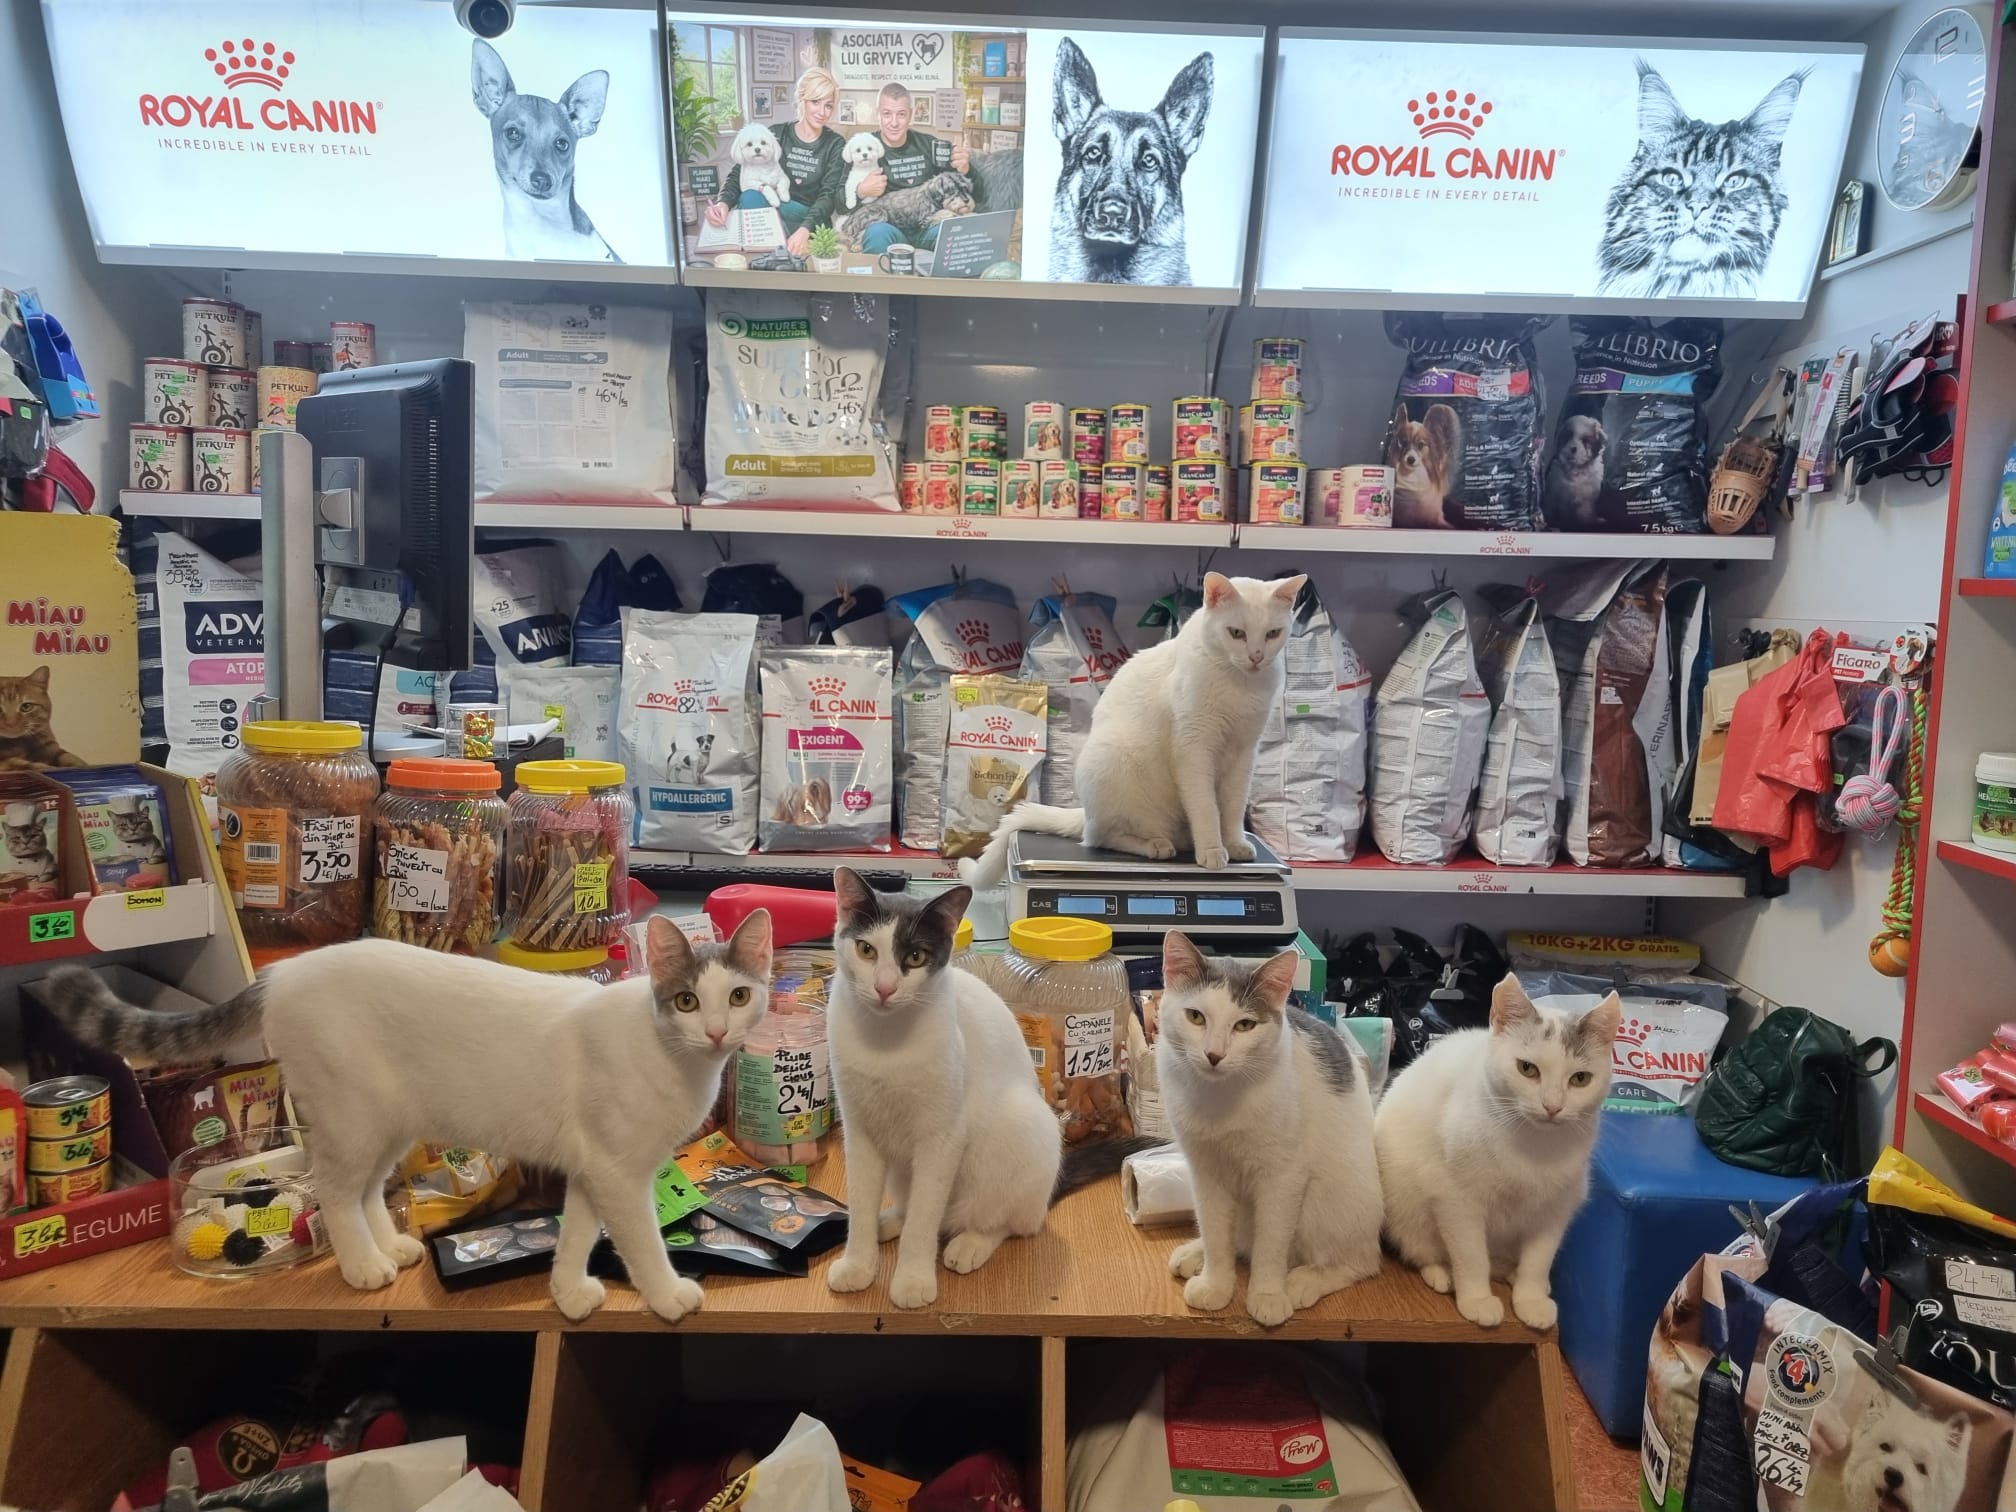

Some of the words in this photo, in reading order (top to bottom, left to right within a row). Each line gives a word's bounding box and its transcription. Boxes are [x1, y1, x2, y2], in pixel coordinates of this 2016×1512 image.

[841, 52, 860, 65] LUI
[863, 51, 913, 65] GRYVEY
[139, 94, 254, 130] ROYAL
[260, 98, 377, 134] CANIN
[158, 138, 245, 152] INCREDIBLE
[250, 141, 266, 152] IN
[272, 142, 315, 154] EVERY
[321, 144, 372, 156] DETAIL
[1331, 144, 1436, 178] ROYAL
[1445, 147, 1556, 181] CANIN
[1338, 186, 1421, 199] INCREDIBLE
[1426, 189, 1440, 200] IN
[1445, 189, 1488, 201] EVERY
[1492, 191, 1541, 202] DETAIL
[194, 311, 237, 323] PETKULT
[751, 321, 808, 331] NATURE'S
[335, 334, 368, 344] PETKULT
[751, 329, 808, 338] PROTECTION
[506, 351, 529, 360] Adult
[1624, 356, 1658, 369] Nutrition
[154, 371, 197, 383] PETLT
[1628, 377, 1665, 387] PUPPY
[208, 382, 249, 392] PETKULT
[271, 382, 309, 393] PETKULT
[195, 439, 235, 450] PETKULT
[732, 459, 767, 471] Adult
[936, 529, 961, 537] ROYAL
[962, 529, 988, 538] CANIN
[1505, 547, 1531, 555] CANIN
[490, 600, 510, 614] +25
[195, 613, 265, 637] ADV
[984, 640, 1024, 663] CANIN
[678, 696, 696, 714] 82
[828, 699, 876, 713] CANIN
[801, 735, 845, 746] EXIGENT
[961, 731, 997, 744] ROYAL
[1000, 733, 1037, 747] CANIN
[974, 770, 1004, 780] Bichon
[652, 791, 727, 805] HYPOALLERGENIC
[43, 800, 59, 810] 1+
[719, 815, 731, 825] S
[302, 850, 351, 882] 3,50
[390, 880, 419, 907] 1,50
[1482, 885, 1508, 893] CANIN
[1032, 900, 1051, 908] CAS
[1106, 902, 1116, 911] kg
[35, 918, 49, 939] 3
[1528, 933, 1636, 953] 10KG+2KG
[1639, 941, 1680, 954] GRATIS
[1627, 1051, 1704, 1073] CANIN
[1617, 1087, 1648, 1098] CARE
[778, 1084, 801, 1115] 2
[1947, 1264, 1979, 1293] 24
[1773, 1334, 1833, 1375] INTEGRAMIX
[1787, 1359, 1806, 1384] 4
[1769, 1369, 1779, 1390] Food
[1776, 1386, 1826, 1405] complements
[1756, 1443, 1790, 1484] 26
